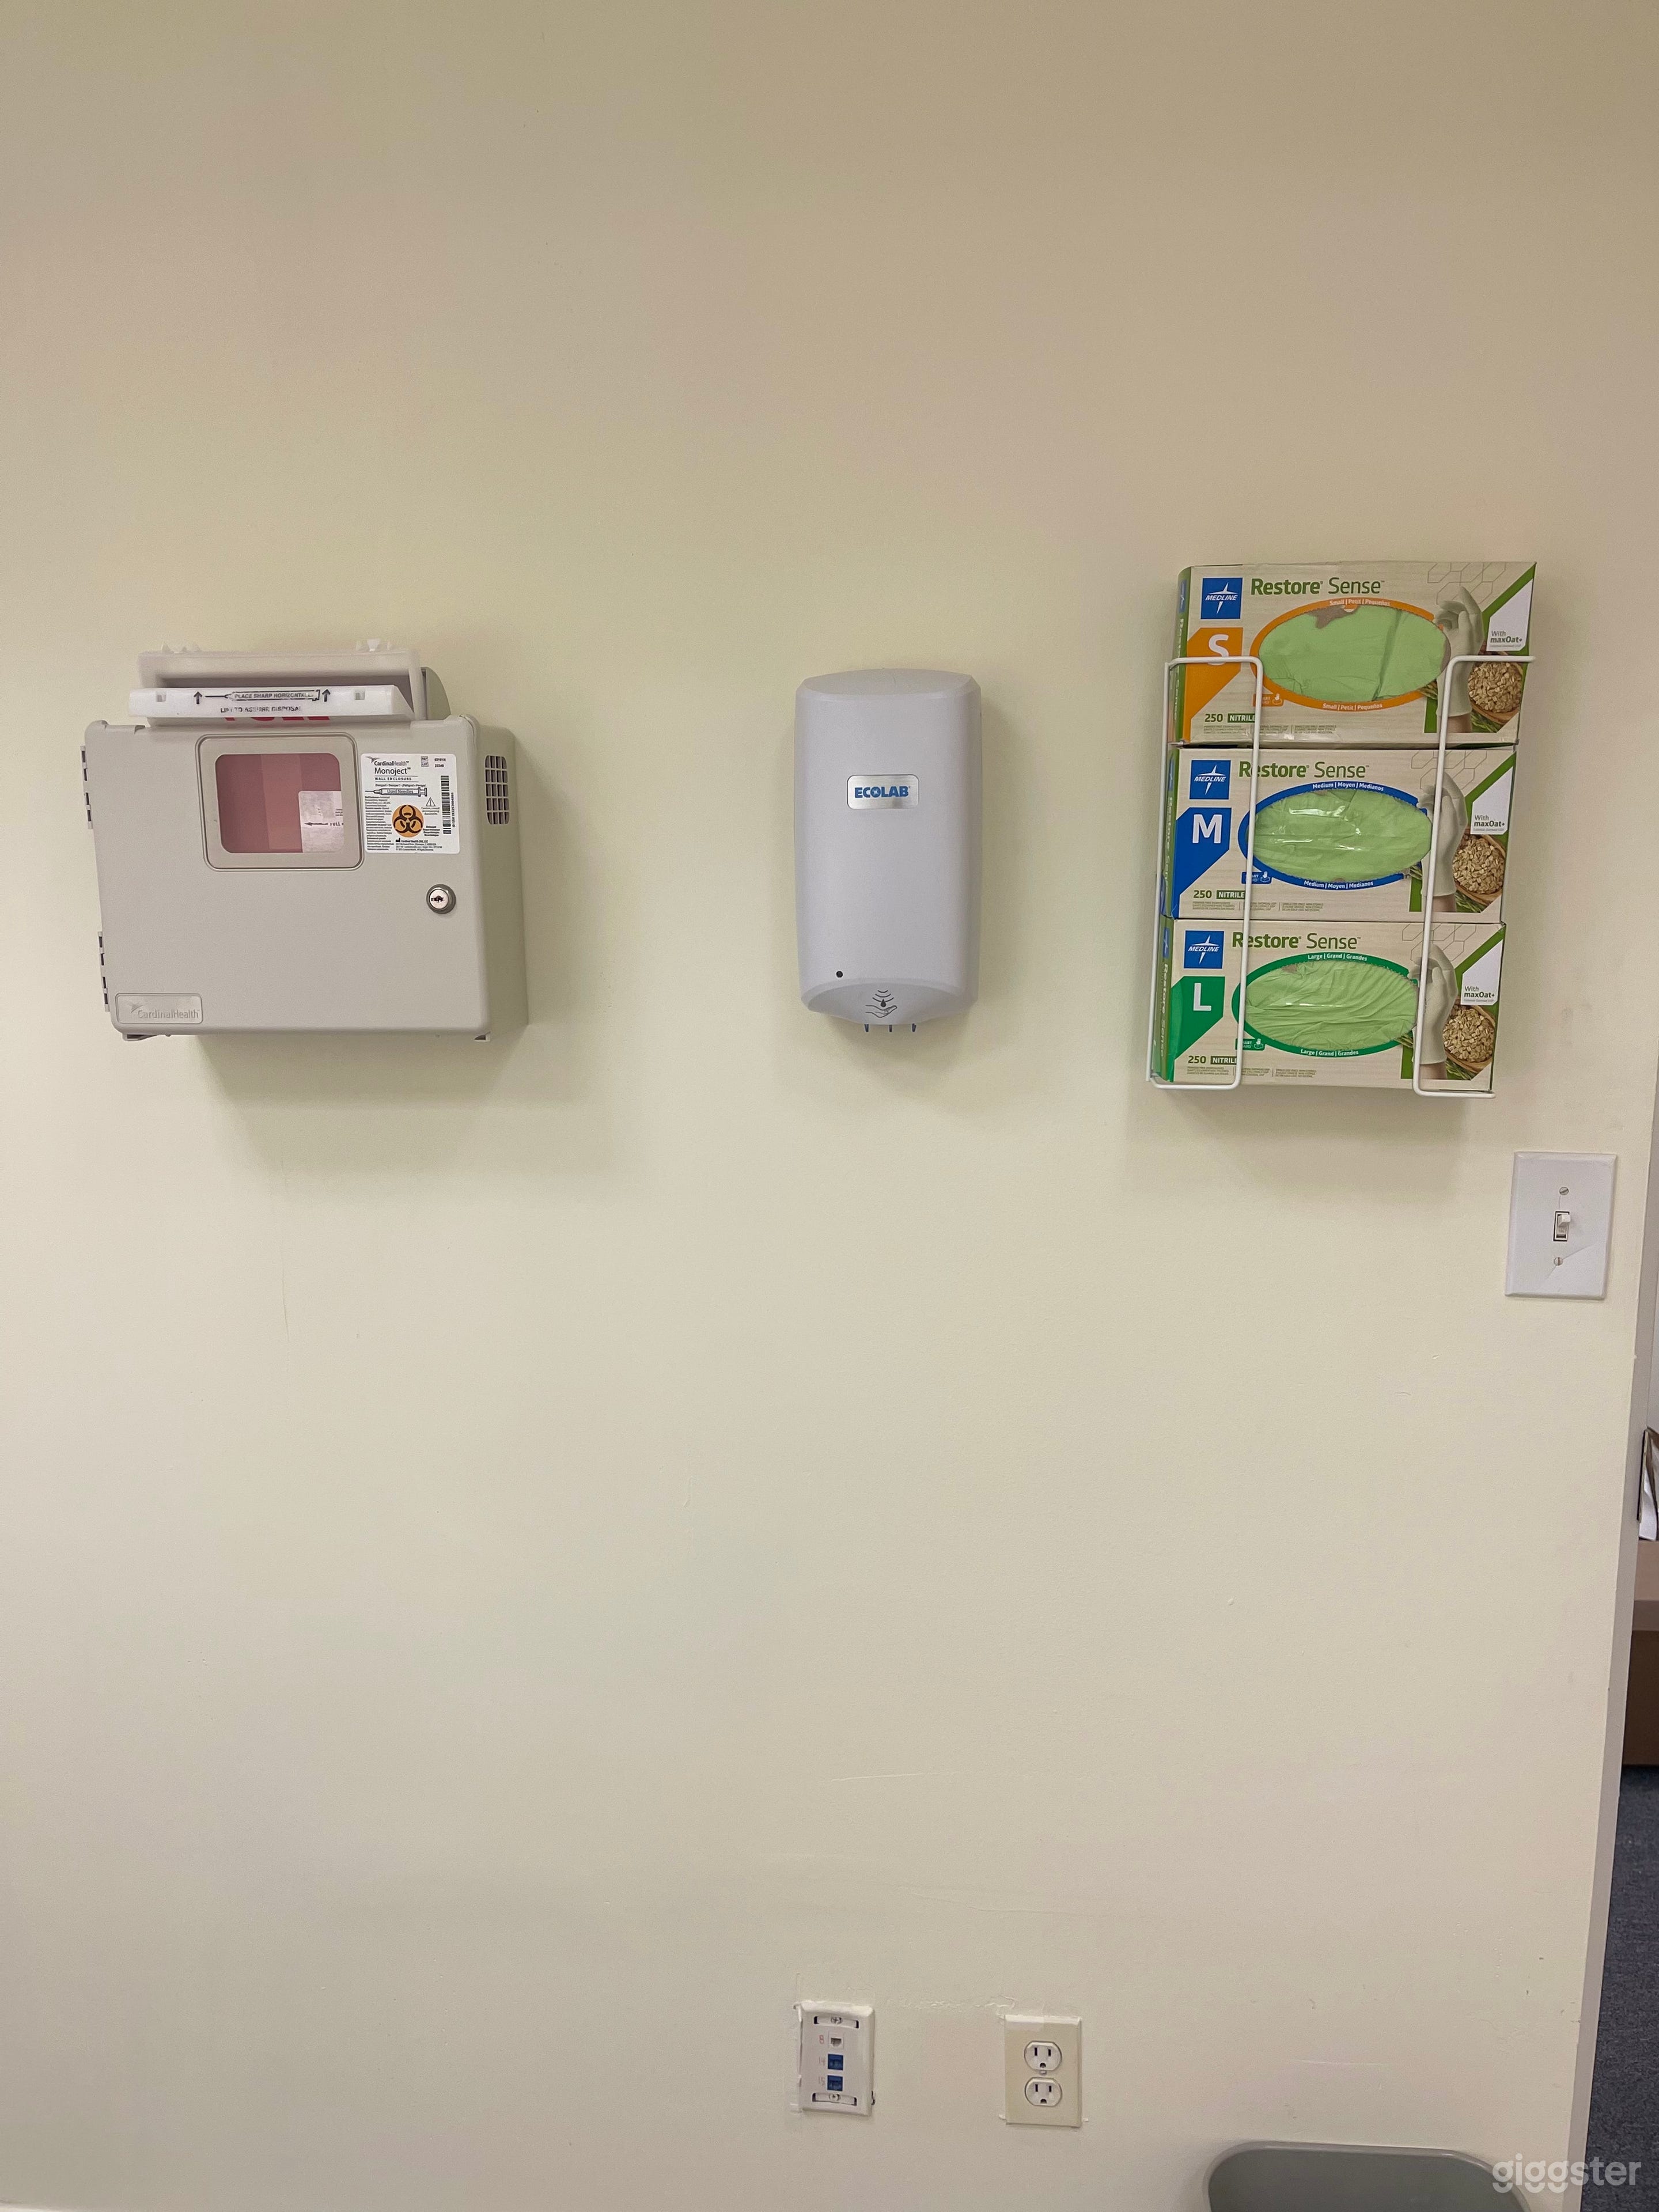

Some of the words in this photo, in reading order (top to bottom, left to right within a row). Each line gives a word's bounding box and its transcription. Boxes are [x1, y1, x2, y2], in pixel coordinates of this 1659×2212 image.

[1209, 634, 1229, 666] S
[1205, 713, 1224, 722] 250
[854, 786, 909, 798] ECOLAB
[1359, 783, 1384, 791] Medianos
[1192, 814, 1222, 843] M
[1193, 890, 1213, 899] 250
[1194, 983, 1212, 1012] L
[1188, 1055, 1207, 1064] 250
